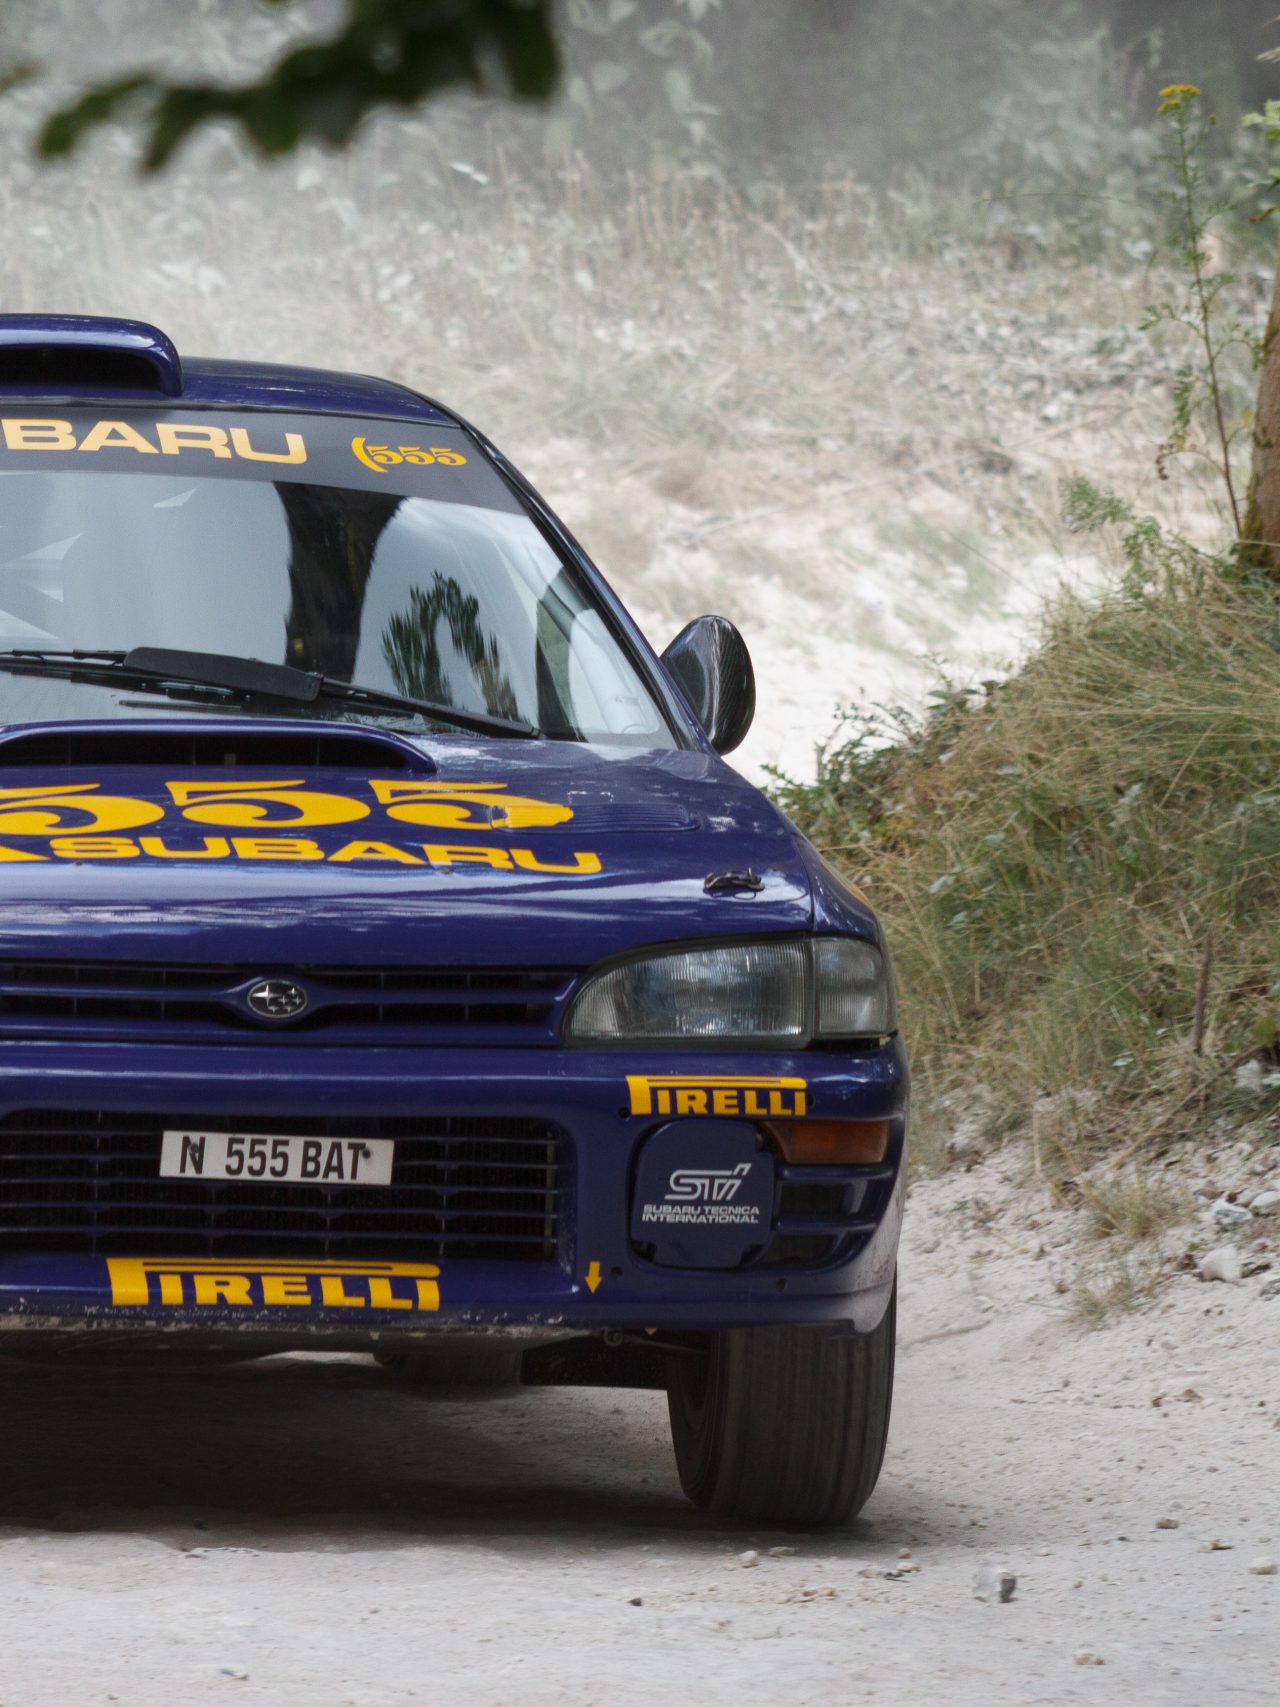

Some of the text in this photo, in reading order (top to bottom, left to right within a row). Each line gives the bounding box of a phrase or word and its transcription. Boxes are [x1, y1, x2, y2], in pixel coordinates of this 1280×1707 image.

[48, 836, 603, 875] SUBARU
[625, 1075, 807, 1117] PIRELLI
[224, 1136, 291, 1178] 555
[299, 1139, 368, 1181] BAT
[641, 1213, 759, 1224] INTERNATIONAL
[642, 1204, 760, 1216] SUBARU TECNICA
[106, 1257, 441, 1312] PIRELLI
